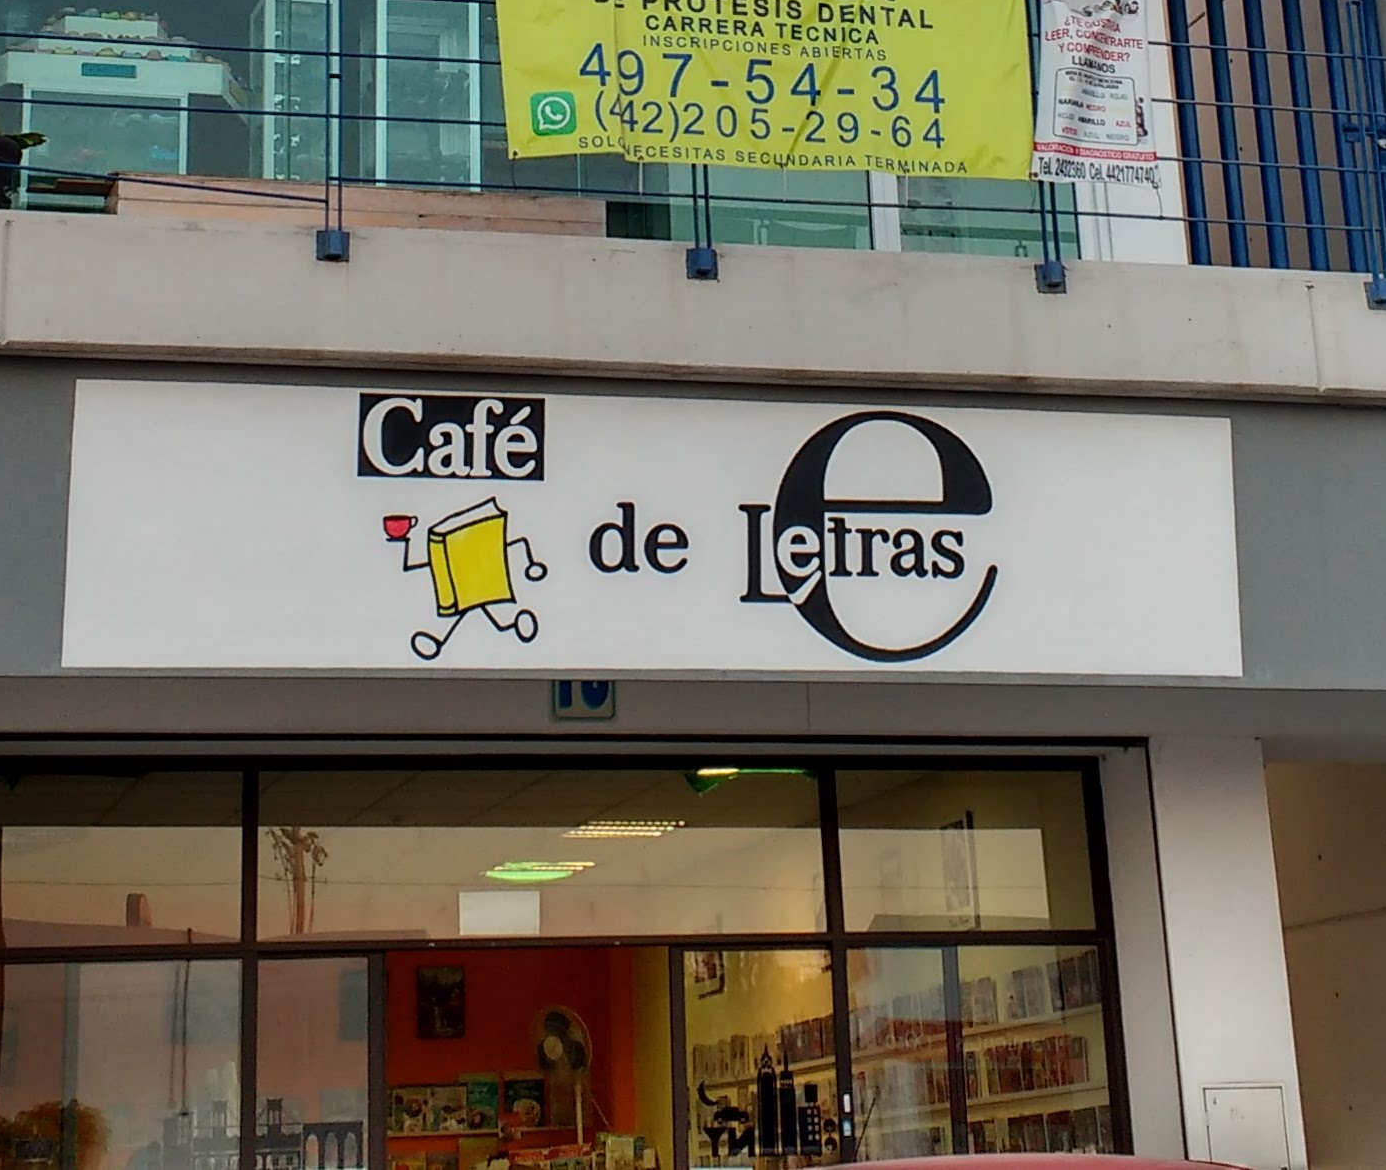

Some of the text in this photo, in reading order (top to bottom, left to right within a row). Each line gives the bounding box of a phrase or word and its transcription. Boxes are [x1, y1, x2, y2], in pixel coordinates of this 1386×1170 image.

[644, 14, 879, 45] CARRERA TECNICA
[1044, 28, 1073, 42] LEER,
[642, 35, 887, 61] INSCRIPCIONES ABIERTAS
[1058, 43, 1065, 53] Y
[579, 43, 946, 115] 497-54-34
[622, 144, 727, 163] NECESITAS
[734, 150, 859, 169] SECUNDARIA
[864, 157, 968, 175] TERMINADA
[361, 397, 539, 478] Café
[588, 501, 966, 604] de Letras
